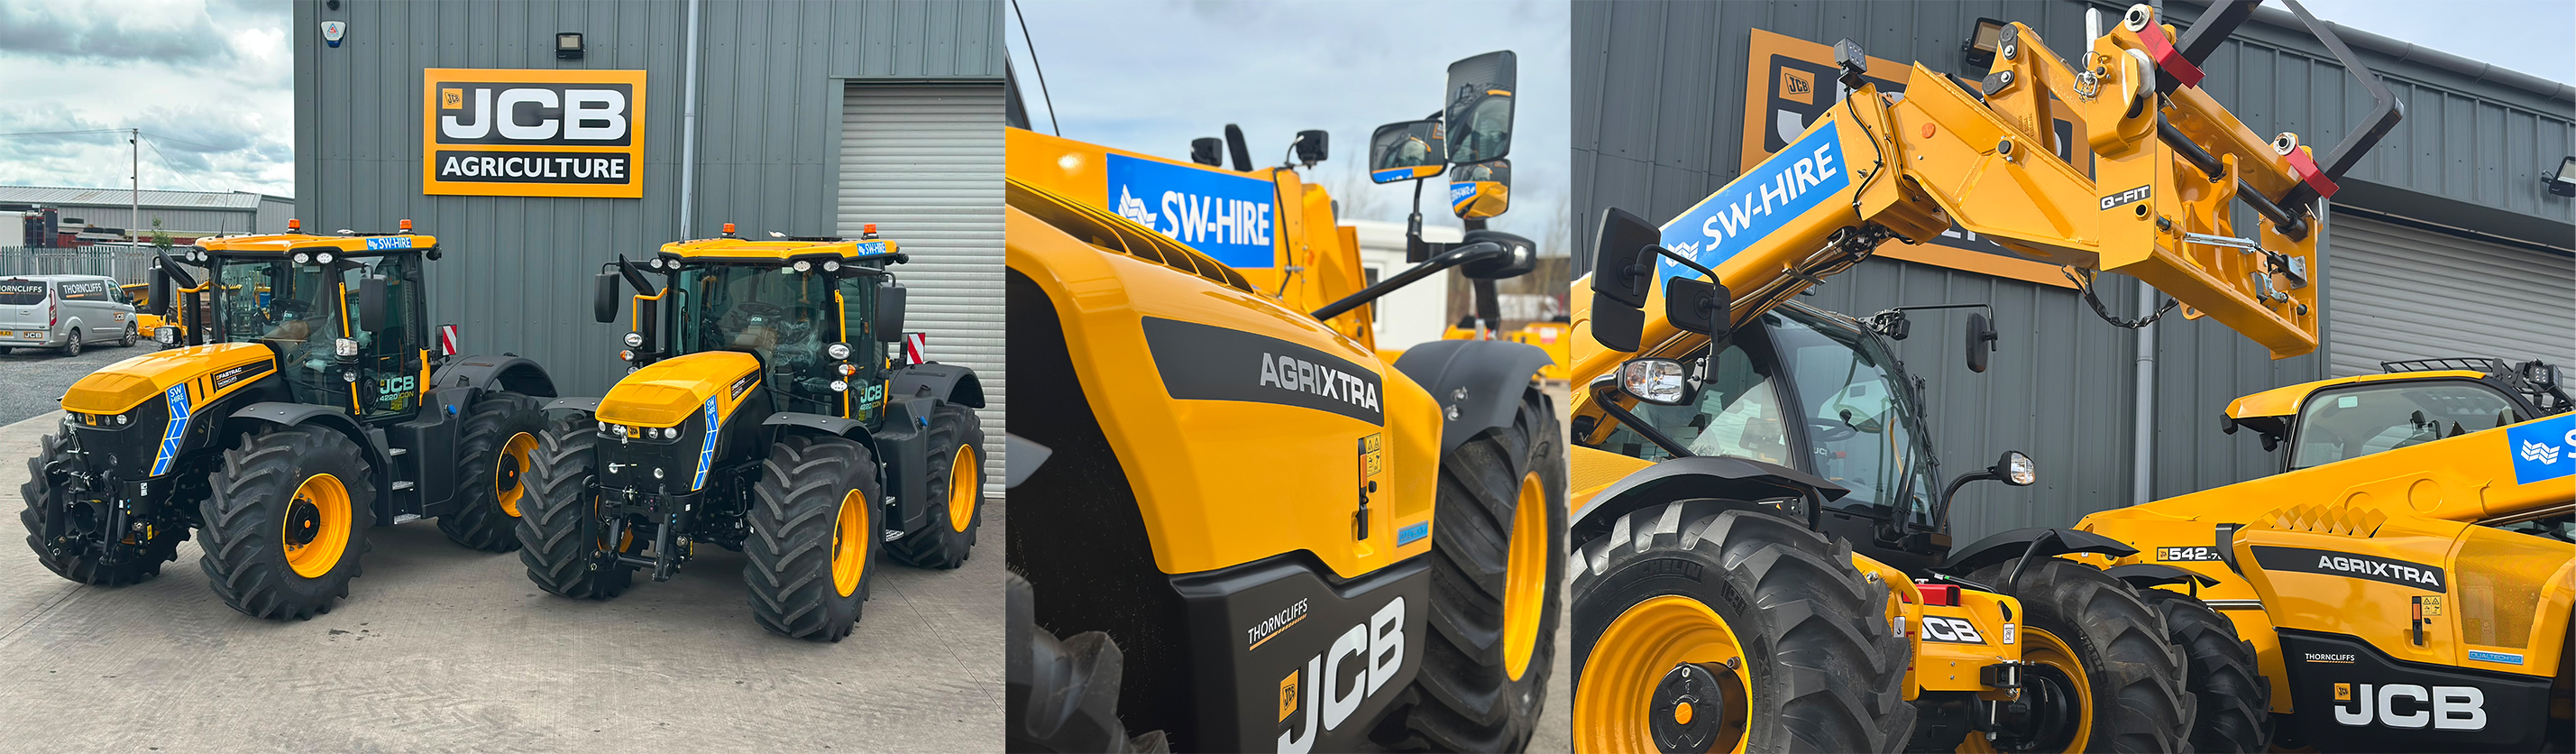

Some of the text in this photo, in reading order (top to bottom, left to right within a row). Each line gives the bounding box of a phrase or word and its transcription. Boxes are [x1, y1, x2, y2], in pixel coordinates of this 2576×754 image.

[1789, 76, 1809, 93] JCB
[446, 92, 461, 105] JCB
[442, 88, 627, 140] JCB
[442, 156, 625, 179] AGRICULTURE
[1702, 142, 1838, 253] SW-HIRE
[2101, 185, 2150, 209] Q-FIT
[1161, 190, 1270, 246] SW-HIRE
[379, 237, 410, 249] SW-HIRE
[866, 242, 885, 254] SW-HIRE
[0, 285, 42, 293] ORNCLIFFS
[63, 283, 103, 295] THORNCLIFFS
[219, 367, 243, 380] FASTRAC
[1260, 352, 1380, 413] AGRIXTRA
[170, 385, 182, 398] SW
[380, 375, 415, 394] JCB
[861, 384, 883, 403] JCB
[171, 393, 184, 405] HIRE
[380, 393, 398, 402] 4220
[2318, 556, 2440, 587] AGRIXTRA
[1248, 597, 1308, 645] THORNCLIFFS
[2305, 653, 2355, 661] THORNCLIFFS
[1278, 596, 1405, 754] JCB
[1284, 685, 1296, 707] JCB
[2334, 684, 2488, 731] JCB
